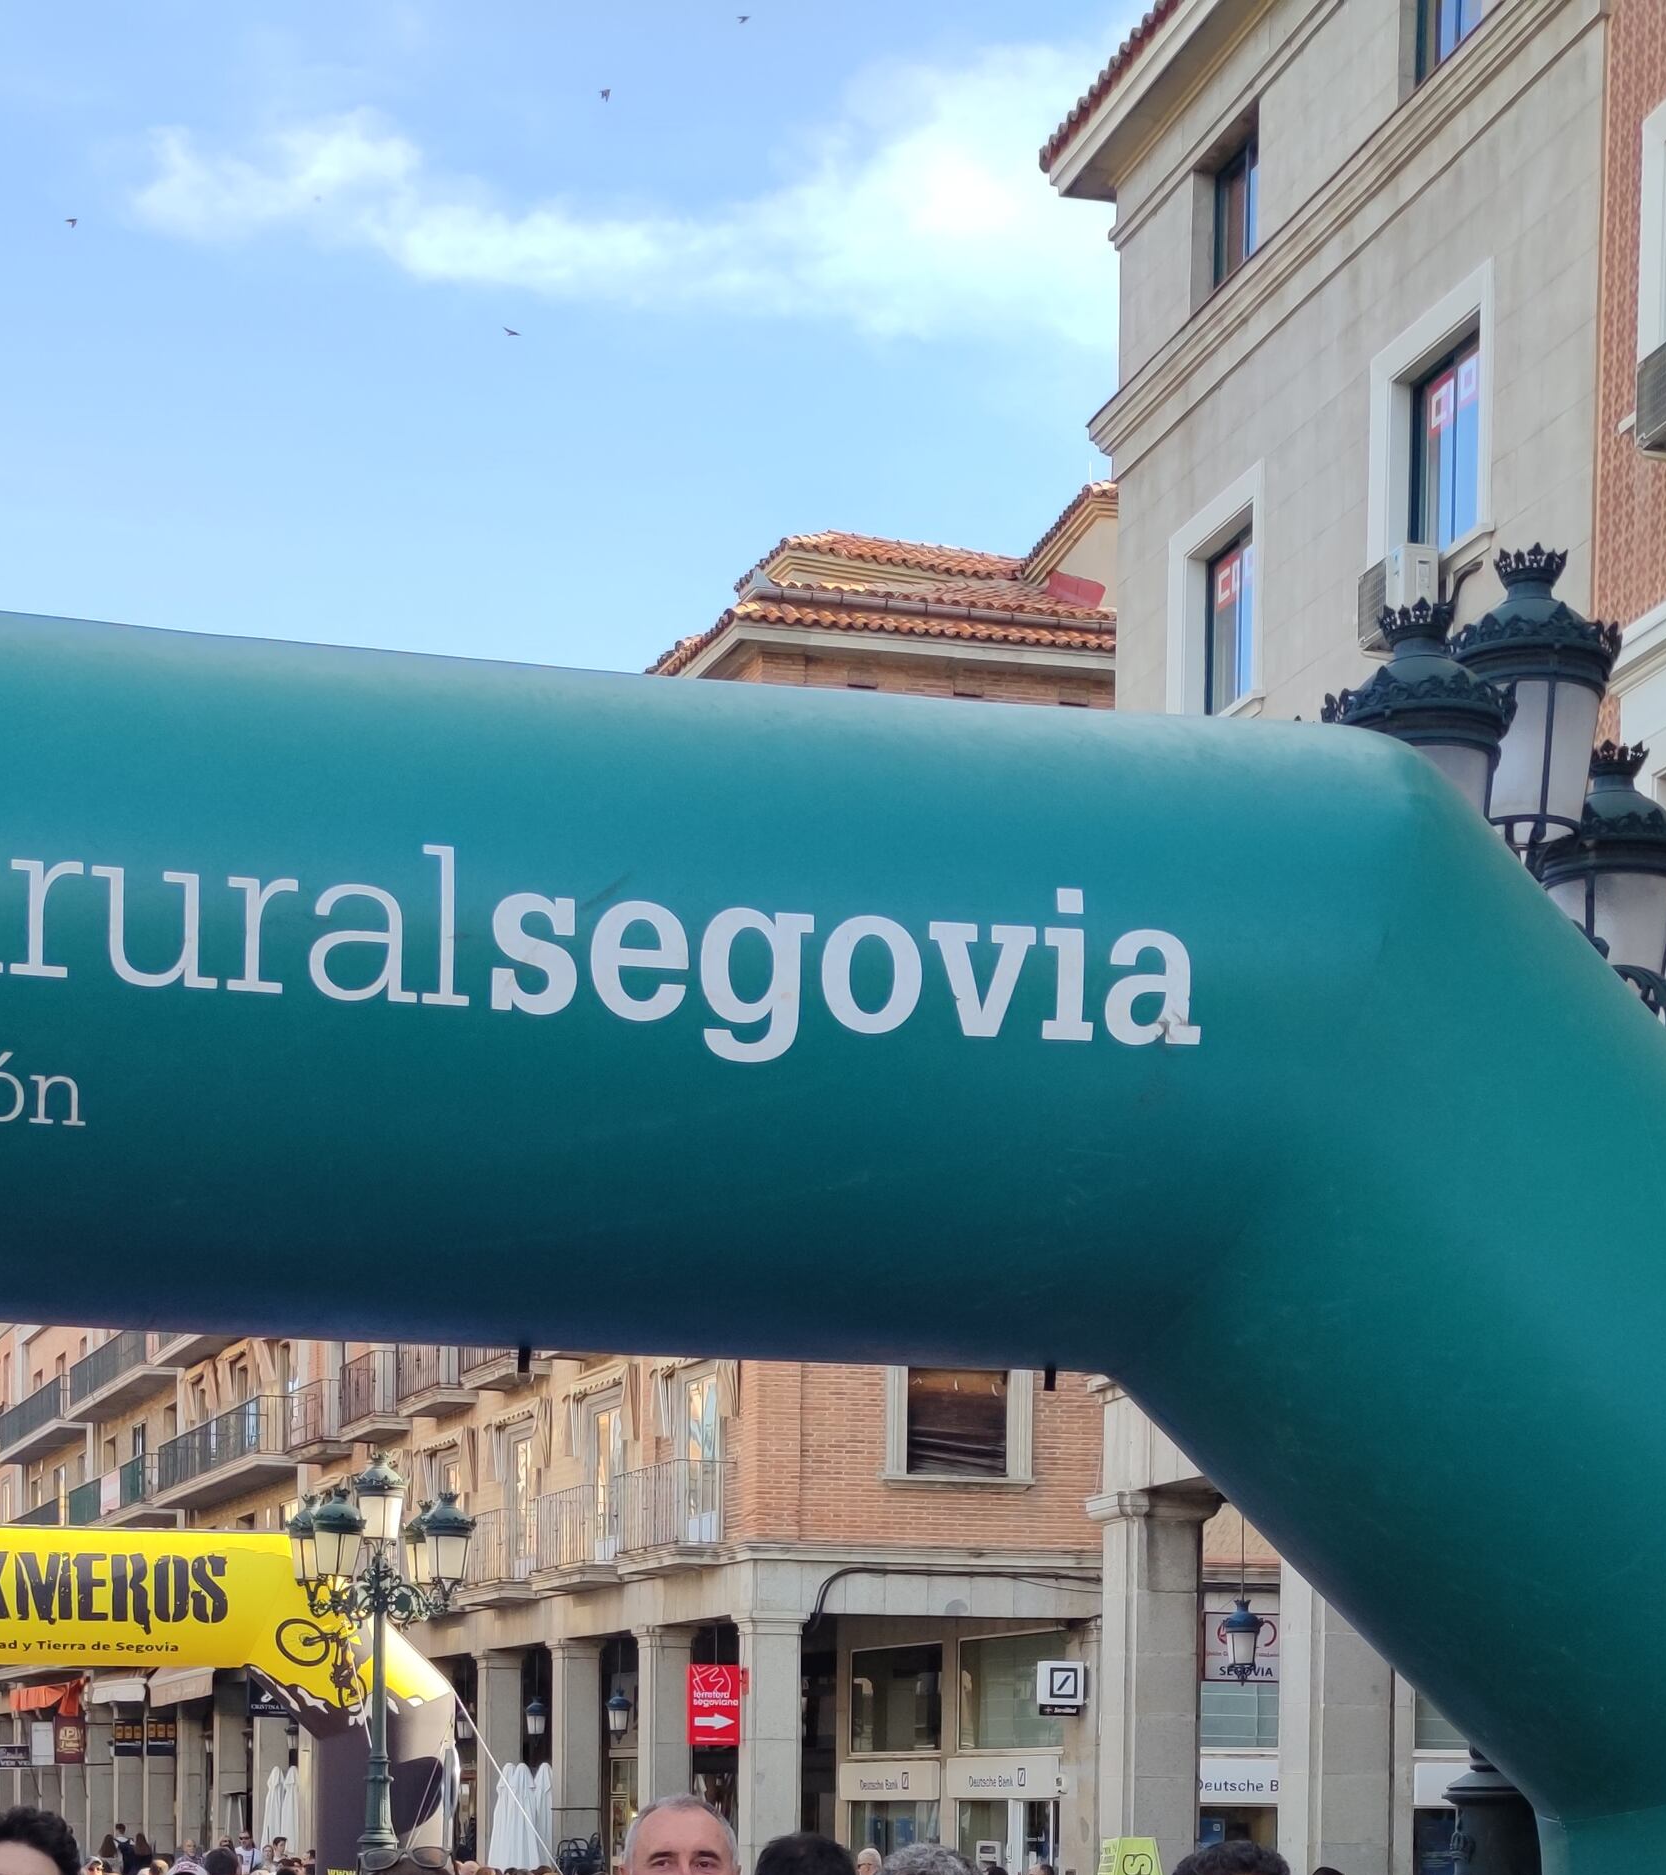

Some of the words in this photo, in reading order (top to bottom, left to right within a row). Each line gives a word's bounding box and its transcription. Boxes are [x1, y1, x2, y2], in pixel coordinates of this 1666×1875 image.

[22, 1641, 32, 1653] y
[36, 1639, 85, 1652] Tierra
[90, 1640, 111, 1652] de
[115, 1641, 179, 1655] Segovia
[969, 1775, 996, 1788] Deutsche
[998, 1775, 1013, 1787] Bank
